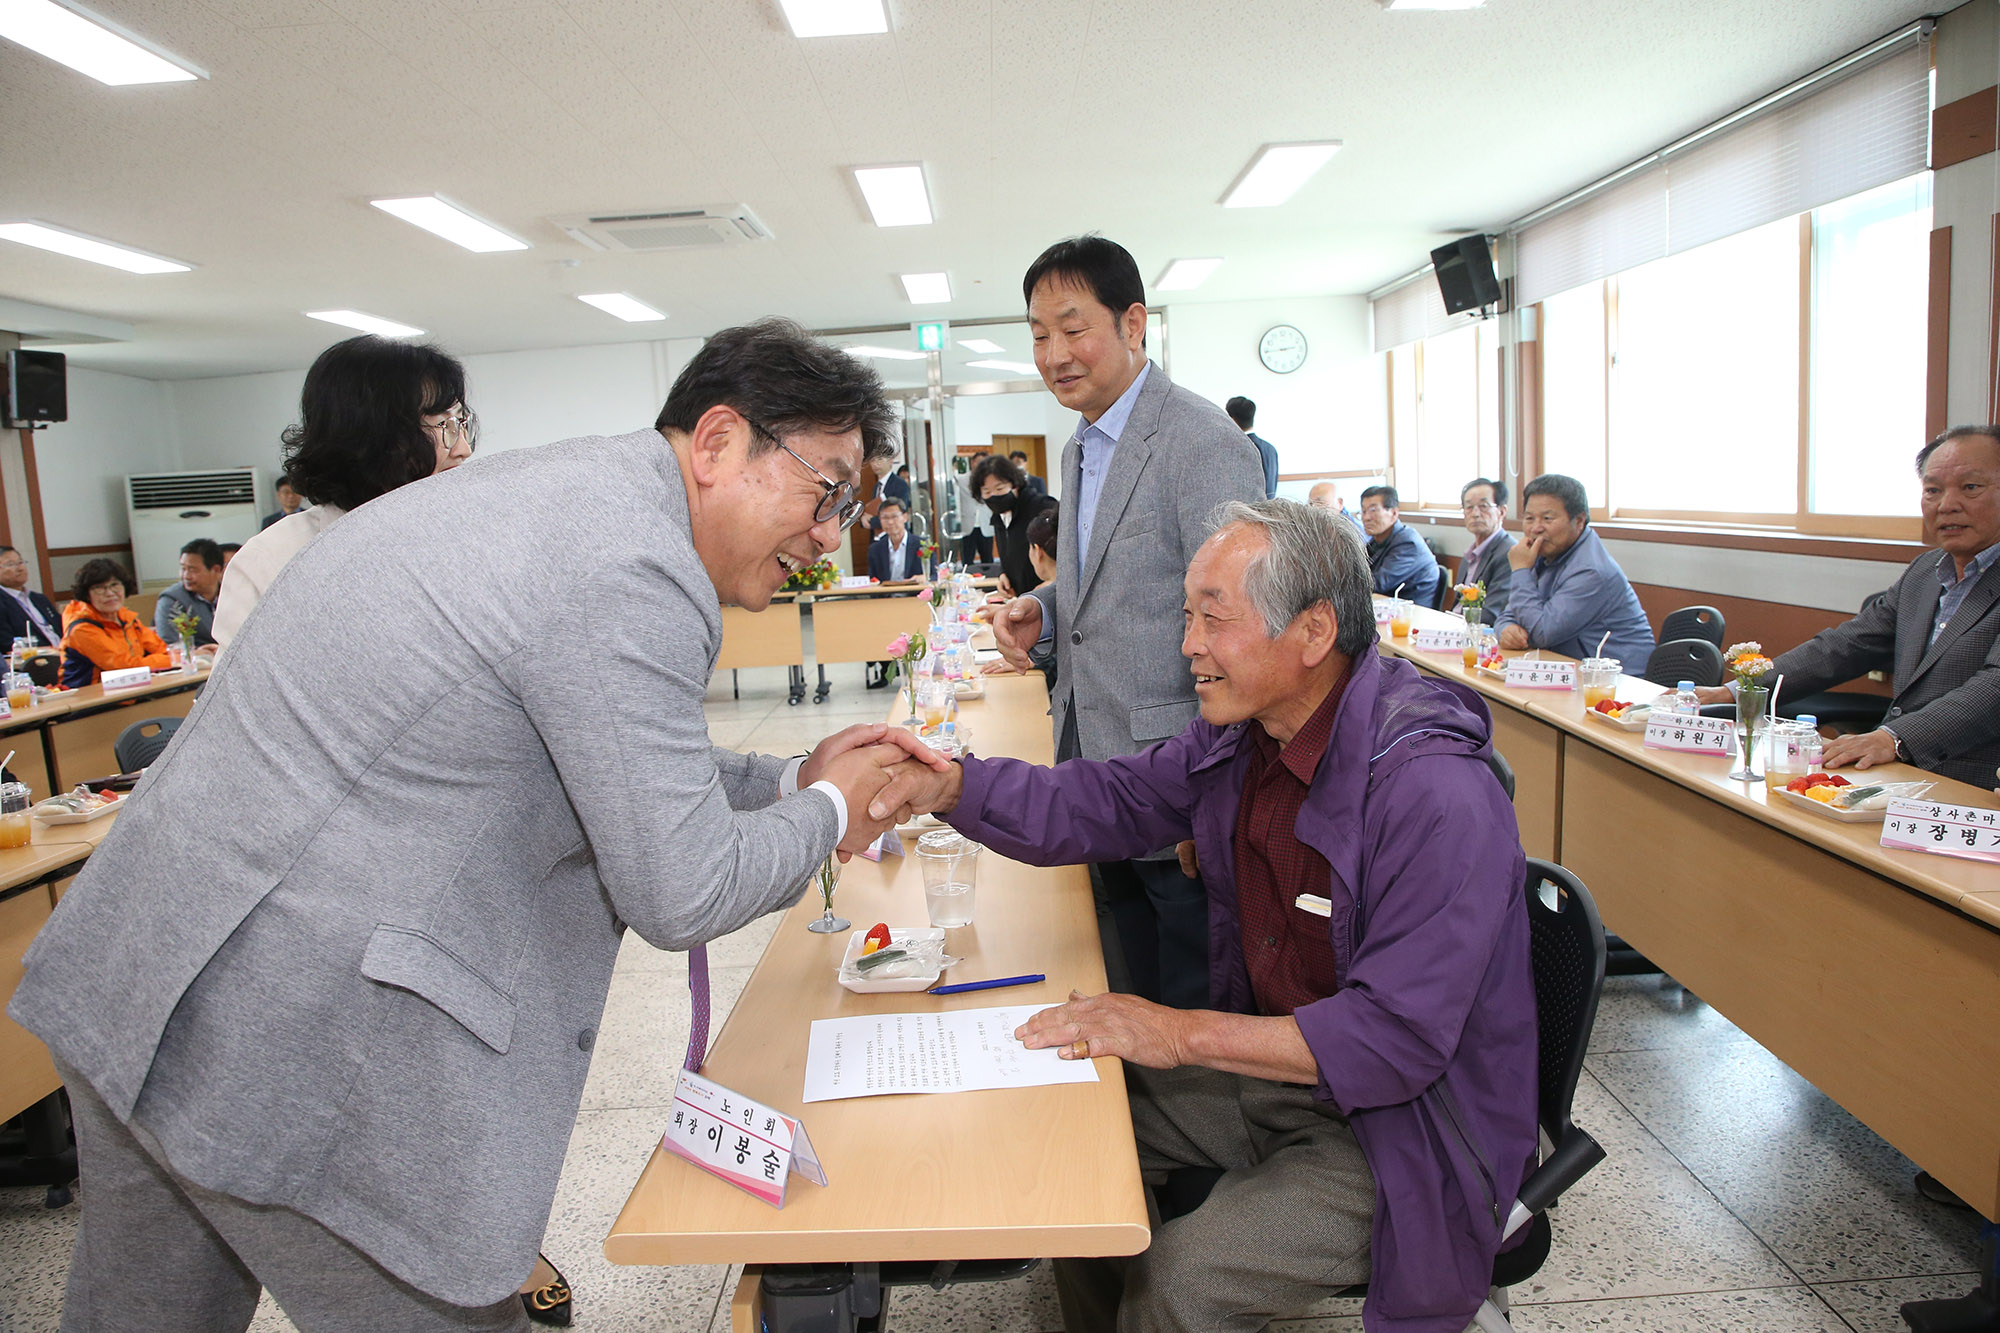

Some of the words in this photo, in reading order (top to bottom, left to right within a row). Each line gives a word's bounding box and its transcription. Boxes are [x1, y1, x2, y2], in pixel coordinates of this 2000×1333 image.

[1673, 730, 1725, 748] 하원식
[1890, 820, 1918, 834] 이장
[720, 1098, 777, 1137] 노인회
[673, 1110, 699, 1135] 회장
[707, 1124, 781, 1181] 이봉술
